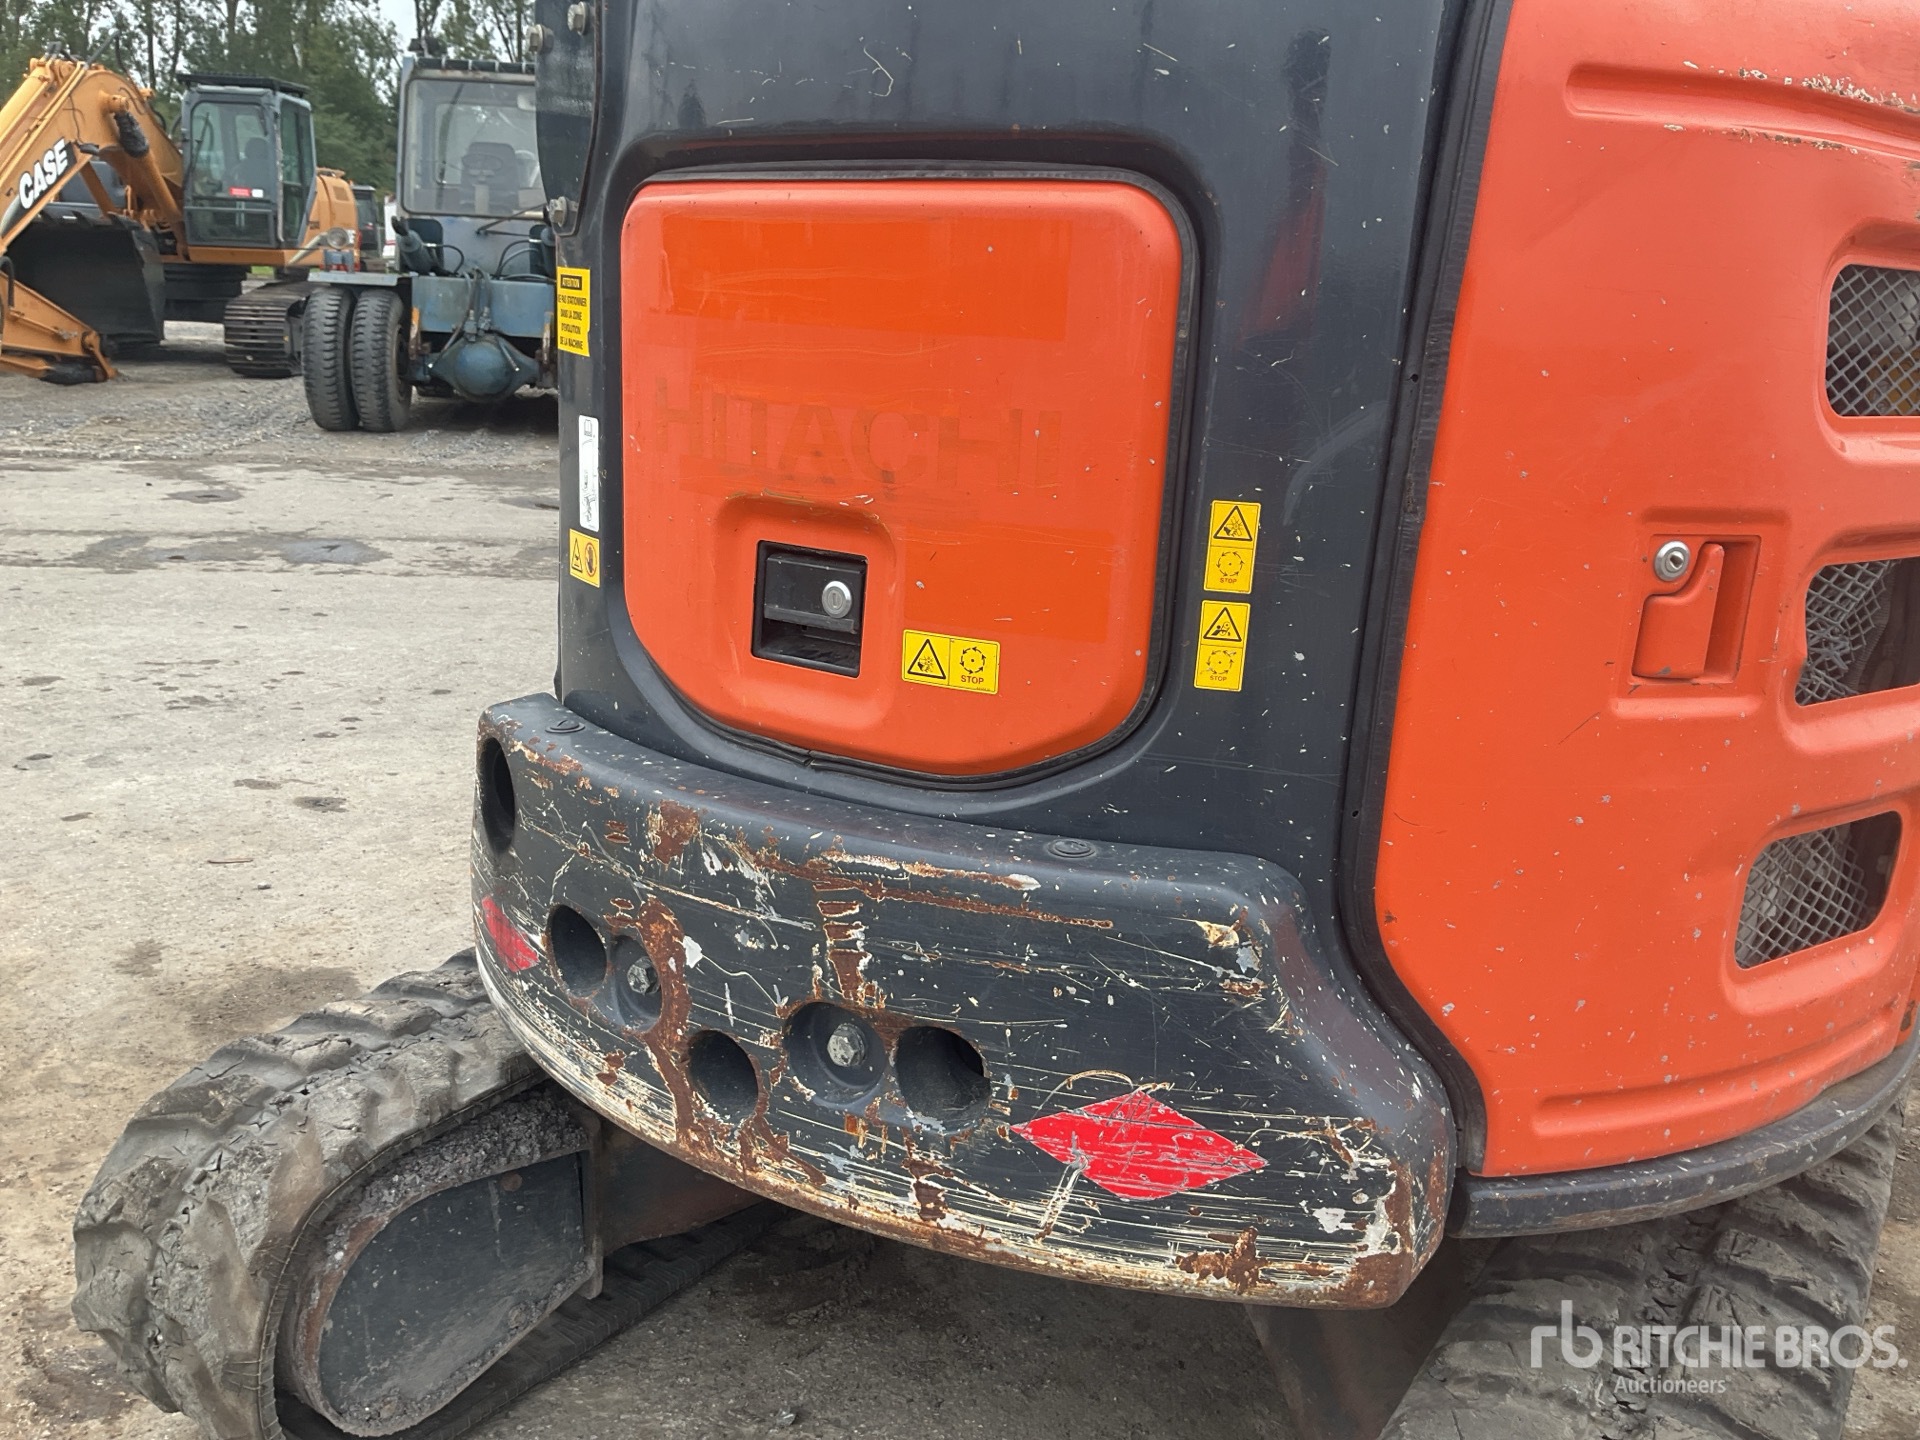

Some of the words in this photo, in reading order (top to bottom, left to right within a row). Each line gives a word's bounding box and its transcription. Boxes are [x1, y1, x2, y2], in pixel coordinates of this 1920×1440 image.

[20, 138, 68, 209] CASE
[655, 376, 1062, 487] HITACHI
[960, 674, 984, 685] STOP
